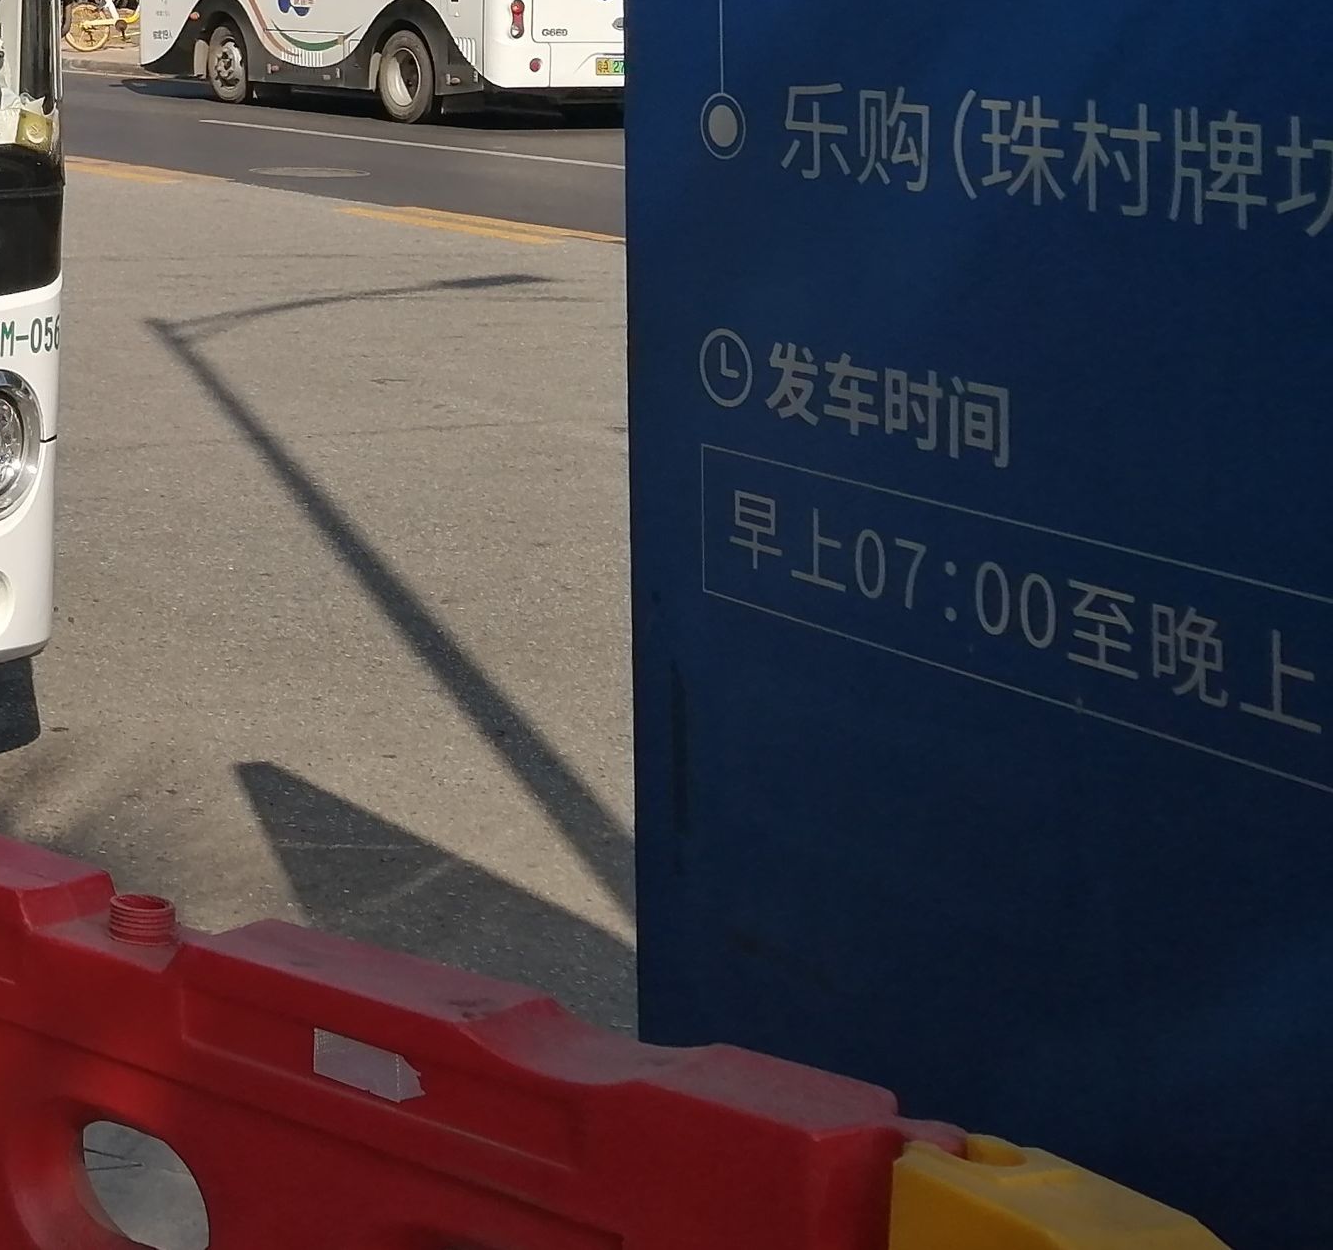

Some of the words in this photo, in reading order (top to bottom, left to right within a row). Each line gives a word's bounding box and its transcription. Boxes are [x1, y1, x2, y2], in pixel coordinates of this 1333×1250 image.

[765, 342, 1010, 468] 发车时间
[728, 489, 1323, 735] 早上07:00至晚上
